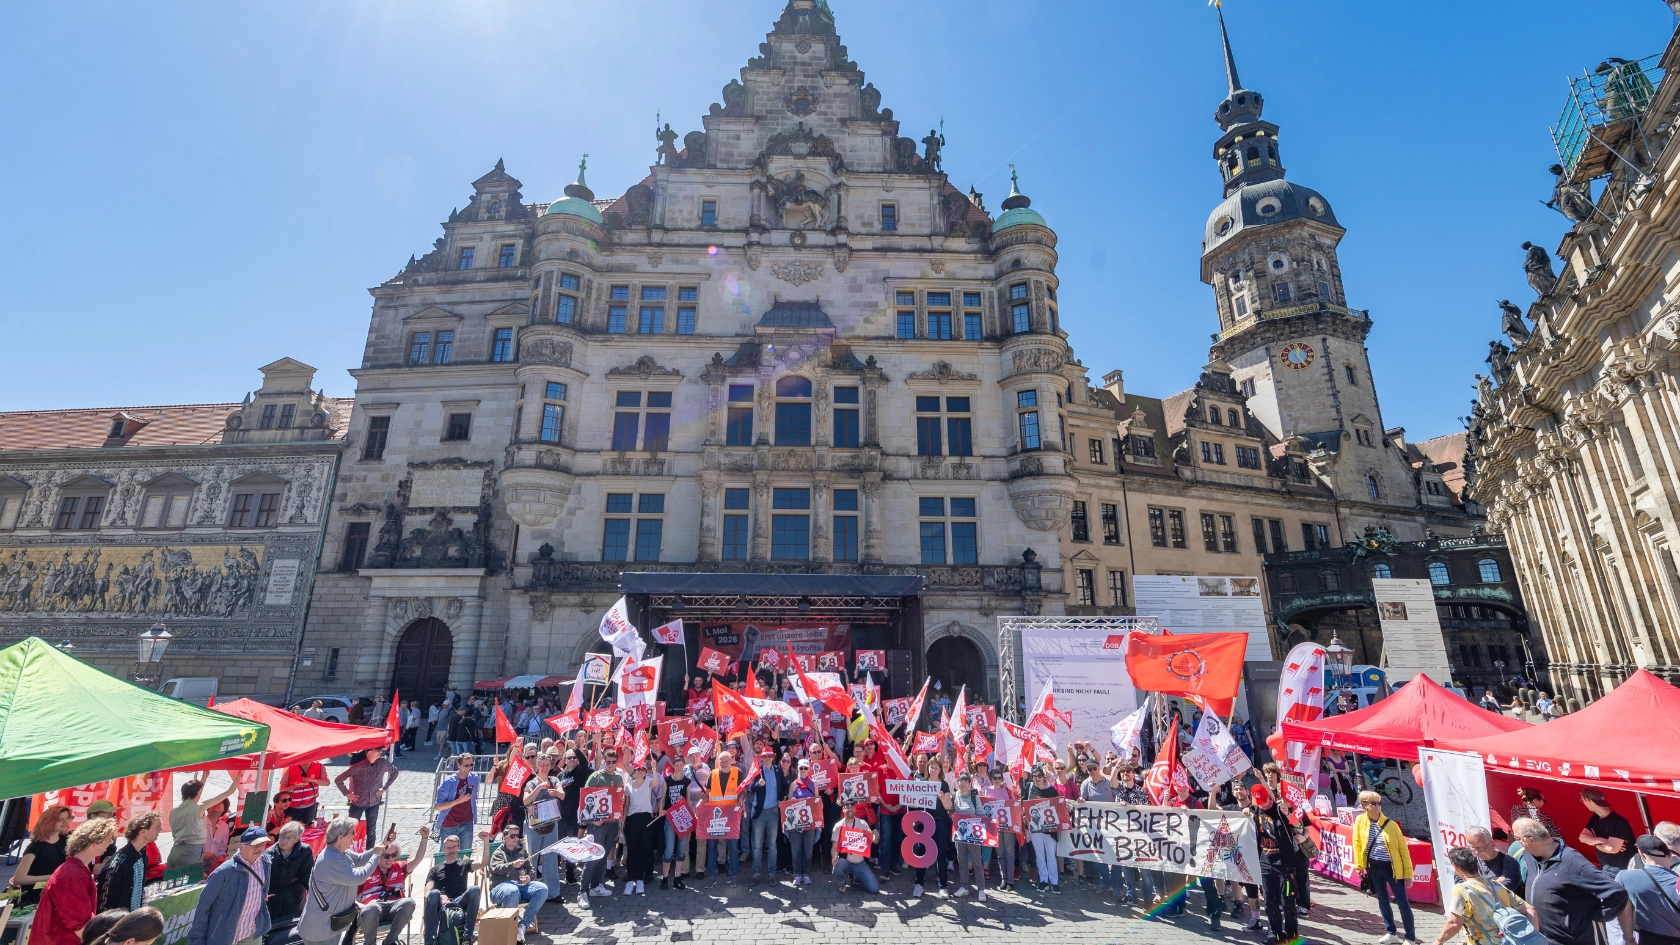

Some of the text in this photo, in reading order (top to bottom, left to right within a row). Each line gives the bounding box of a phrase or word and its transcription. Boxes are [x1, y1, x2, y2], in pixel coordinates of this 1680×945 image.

[712, 627, 728, 635] Mai
[760, 632, 775, 640] Erst
[776, 632, 804, 640] unsere
[796, 644, 822, 652] Profite
[828, 658, 836, 667] 8
[868, 656, 875, 666] 8
[898, 702, 908, 714] 8
[626, 710, 634, 721] 8
[976, 714, 985, 726] 8
[1013, 727, 1036, 741] NGG
[1526, 759, 1552, 772] EVG
[856, 782, 866, 796] 8
[890, 784, 937, 792] Mit Macht
[599, 798, 609, 814] 8
[902, 794, 934, 806] für die
[678, 811, 691, 828] DICH
[798, 808, 810, 823] 8
[997, 808, 1008, 824] 8
[1044, 808, 1056, 824] 8
[972, 824, 983, 838] 8
[901, 810, 938, 868] 8
[1070, 832, 1103, 848] VOM
[1321, 832, 1344, 845] MACH
[1440, 829, 1467, 848] 120
[1114, 836, 1186, 864] BRUTTO
[1326, 842, 1352, 860] DICH
[1320, 853, 1342, 867] STARK
